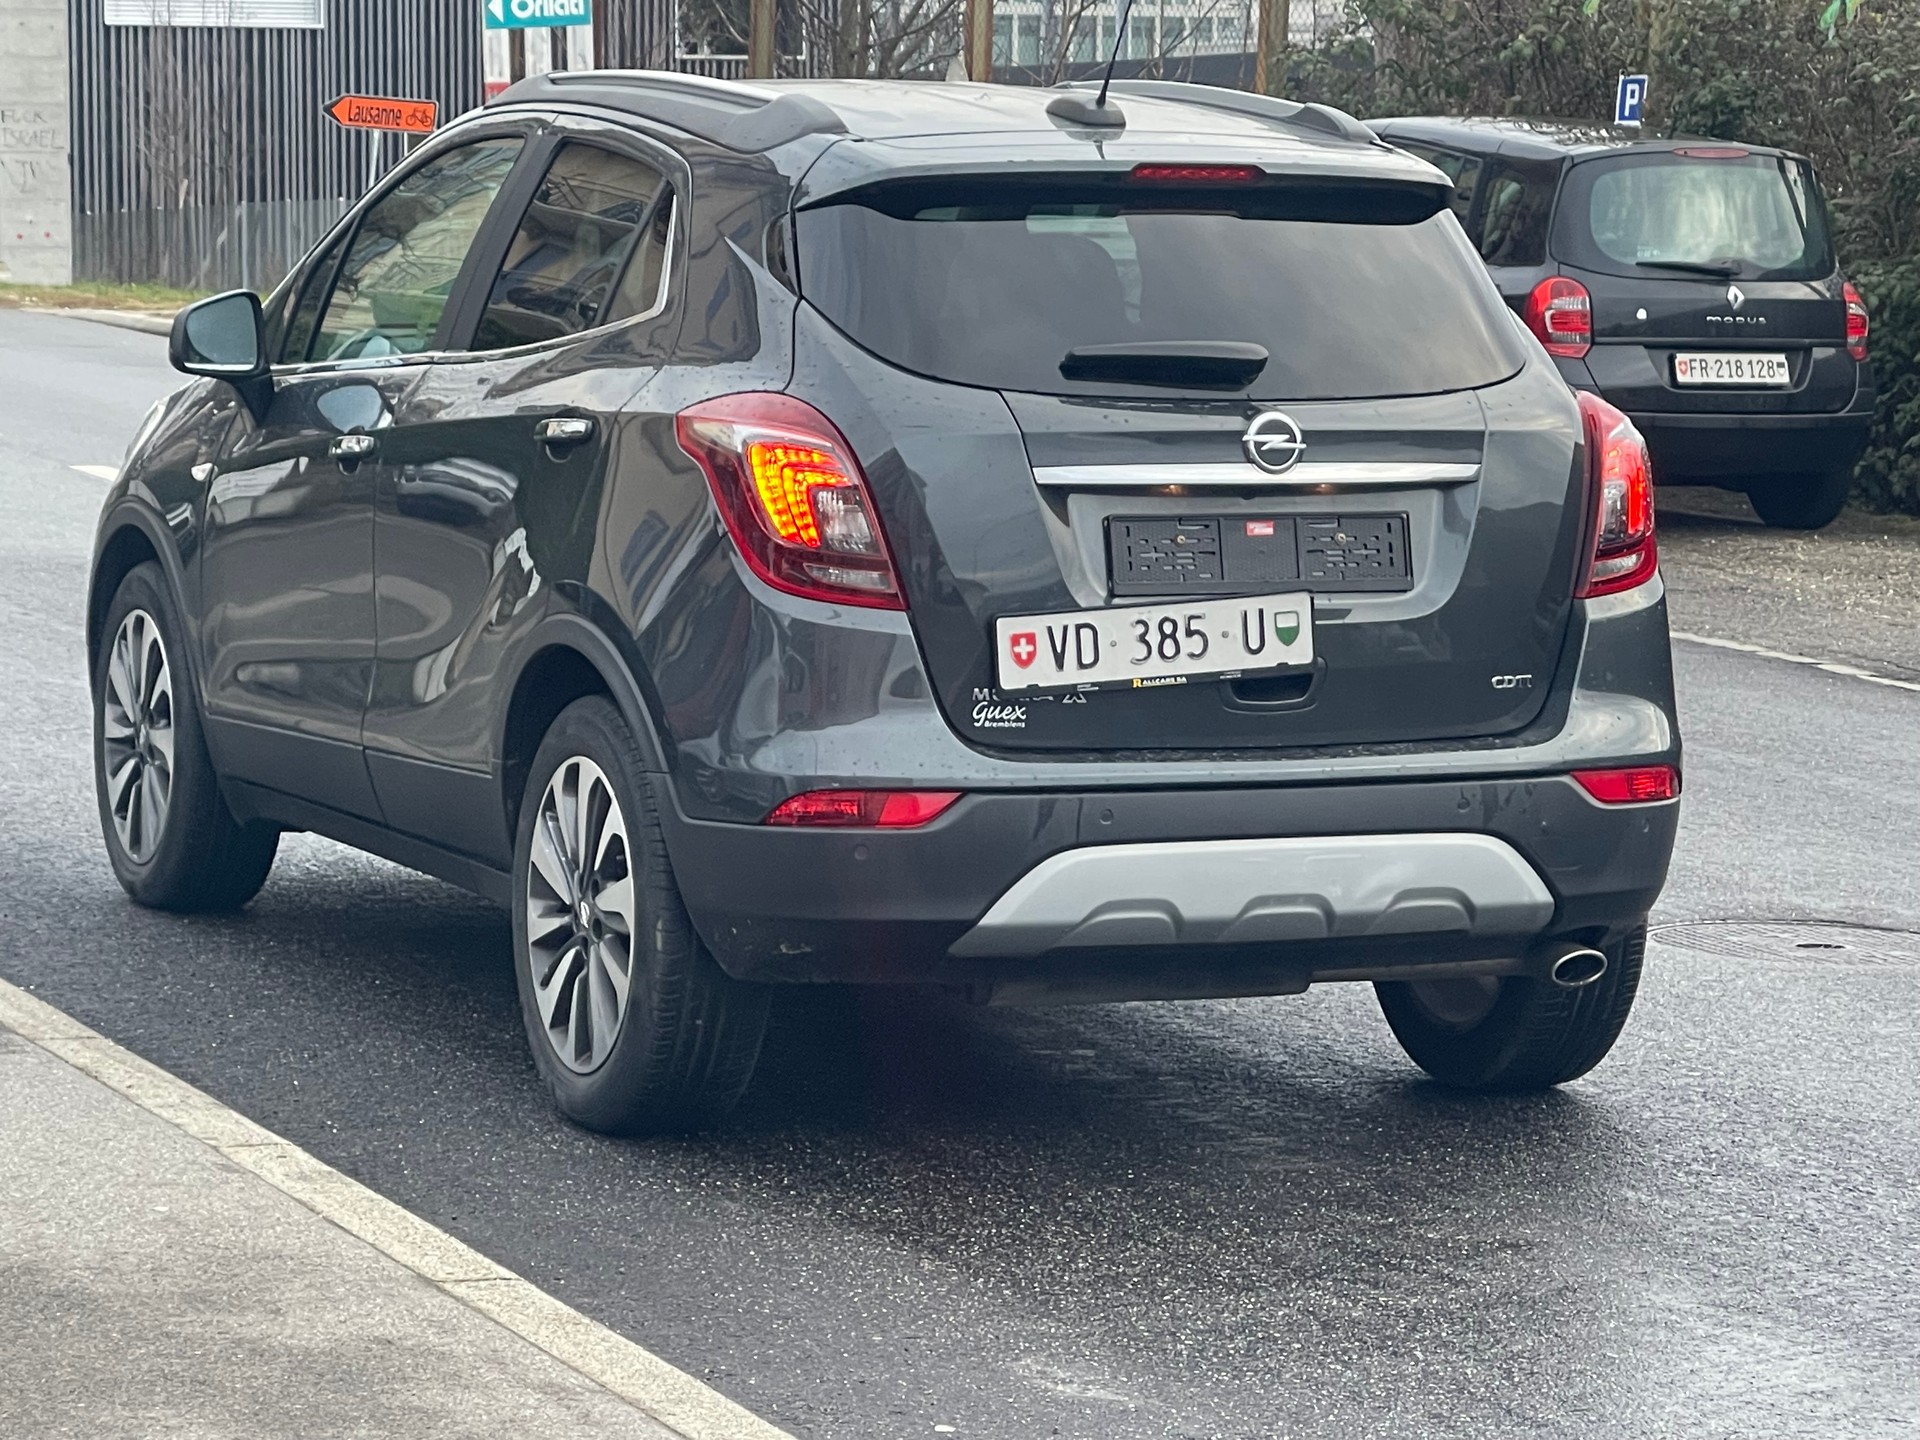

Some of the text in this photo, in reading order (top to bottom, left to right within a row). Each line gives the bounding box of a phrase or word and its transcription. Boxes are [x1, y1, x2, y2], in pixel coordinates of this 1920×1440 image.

[347, 99, 402, 126] Lausanne
[1624, 83, 1640, 117] P
[1688, 358, 1709, 378] FR
[1046, 608, 1266, 672] VD 385 U
[972, 701, 1027, 727] Guex
